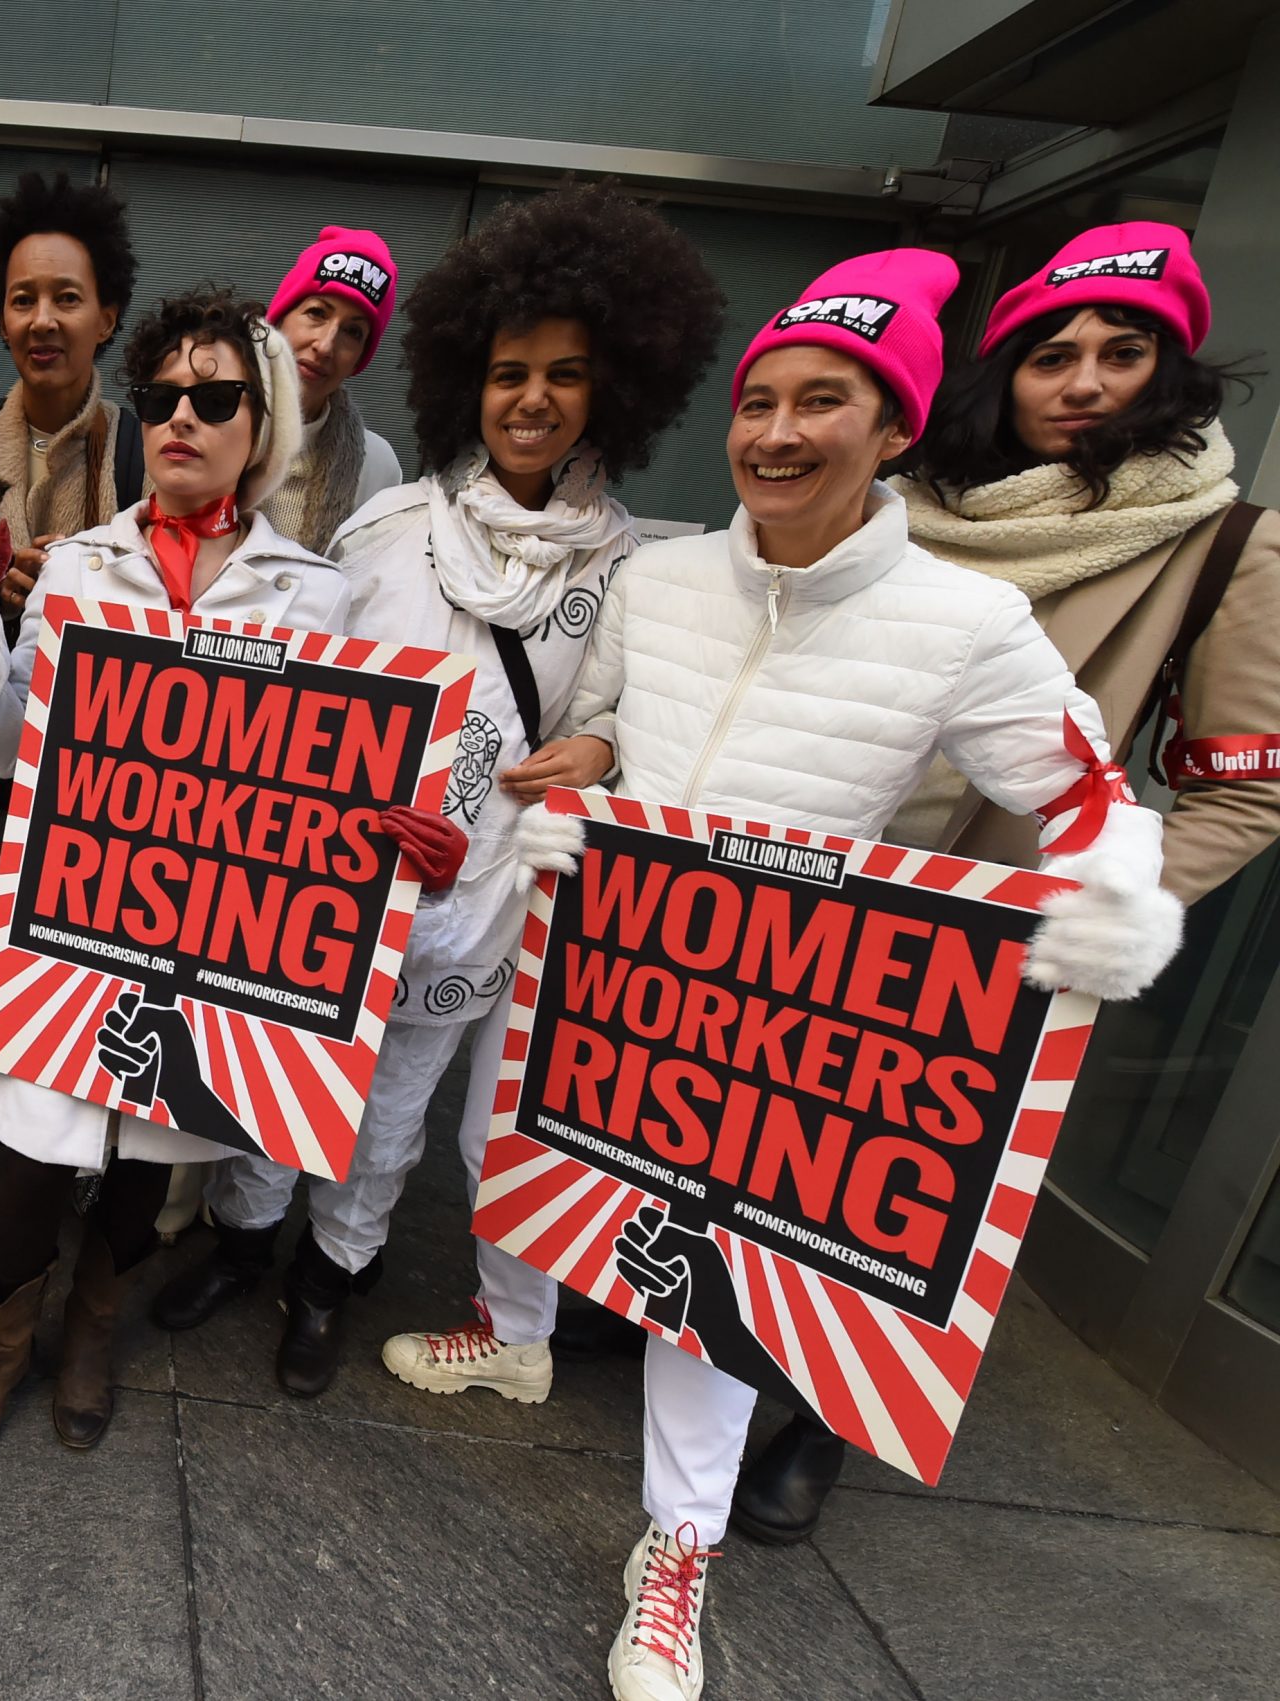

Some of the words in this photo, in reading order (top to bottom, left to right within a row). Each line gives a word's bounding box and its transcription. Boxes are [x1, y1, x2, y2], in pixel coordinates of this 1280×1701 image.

[323, 253, 388, 290] OFW
[340, 273, 359, 285] FAIR
[1052, 273, 1079, 282] ONE
[1084, 268, 1114, 276] FAIR
[1118, 267, 1158, 275] WAGE
[1054, 249, 1165, 276] OFW
[780, 315, 807, 325] ONE
[810, 314, 839, 322] FAIR
[842, 318, 878, 337] WAGE
[787, 297, 894, 325] OFW
[243, 641, 282, 667] RISING
[76, 652, 412, 801] WOMEN
[1211, 750, 1260, 772] Until
[58, 748, 385, 883] WORKERS
[786, 848, 839, 881] RISING
[33, 824, 360, 994] RISING
[582, 848, 1027, 1055] WOMEN
[28, 923, 176, 975] WOMENWORKERSRISING.ORG
[195, 968, 341, 1020] #WOMENWORKERSRISING
[564, 942, 998, 1146] WORKERS
[541, 1017, 956, 1270] RISING
[536, 1113, 707, 1200] WOMENWORKERSRISING.ORG
[733, 1200, 928, 1298] #WOMENWORKERSRISING
